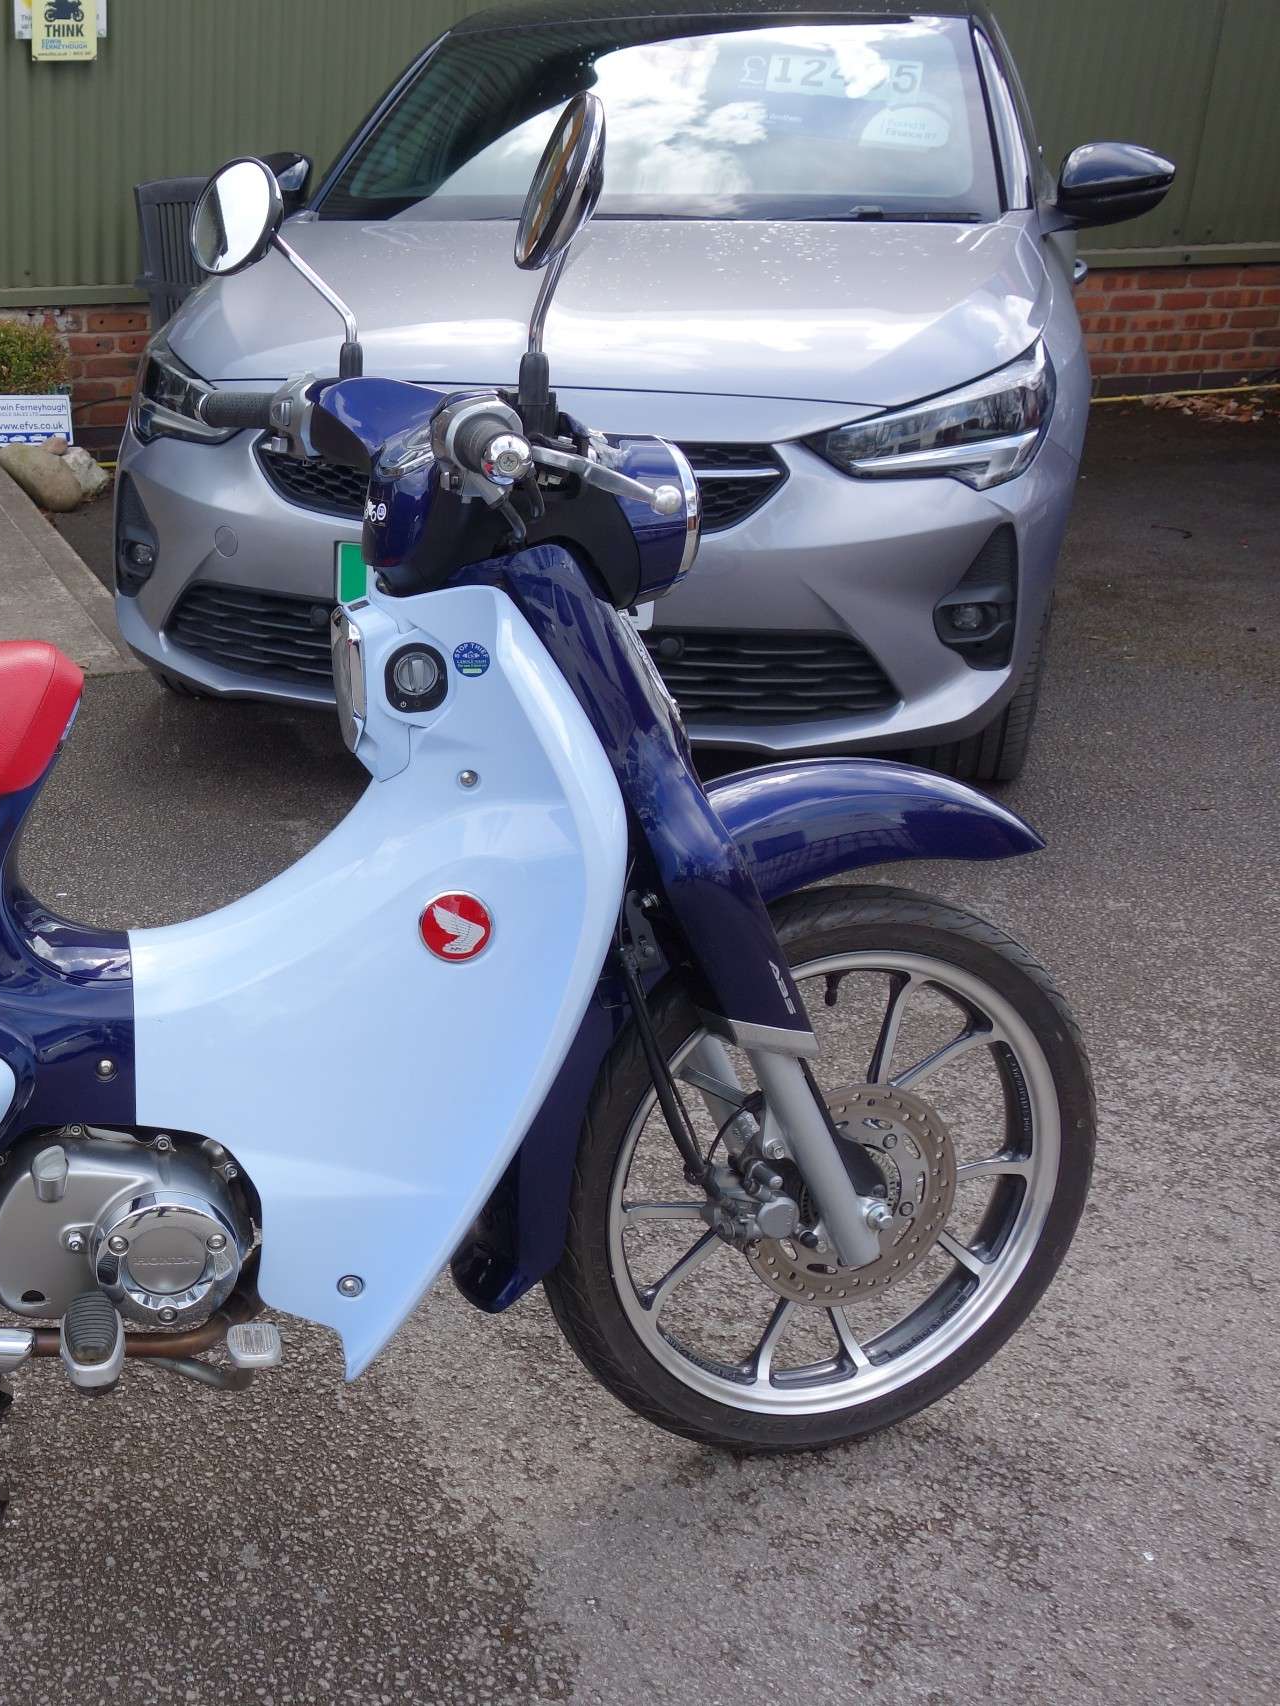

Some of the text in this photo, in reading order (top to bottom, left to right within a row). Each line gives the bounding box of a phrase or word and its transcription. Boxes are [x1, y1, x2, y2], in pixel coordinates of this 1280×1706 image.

[44, 24, 84, 37] THINK
[15, 402, 67, 412] Ferneyhough
[454, 643, 469, 658] STOP
[768, 959, 797, 1015] ABS
